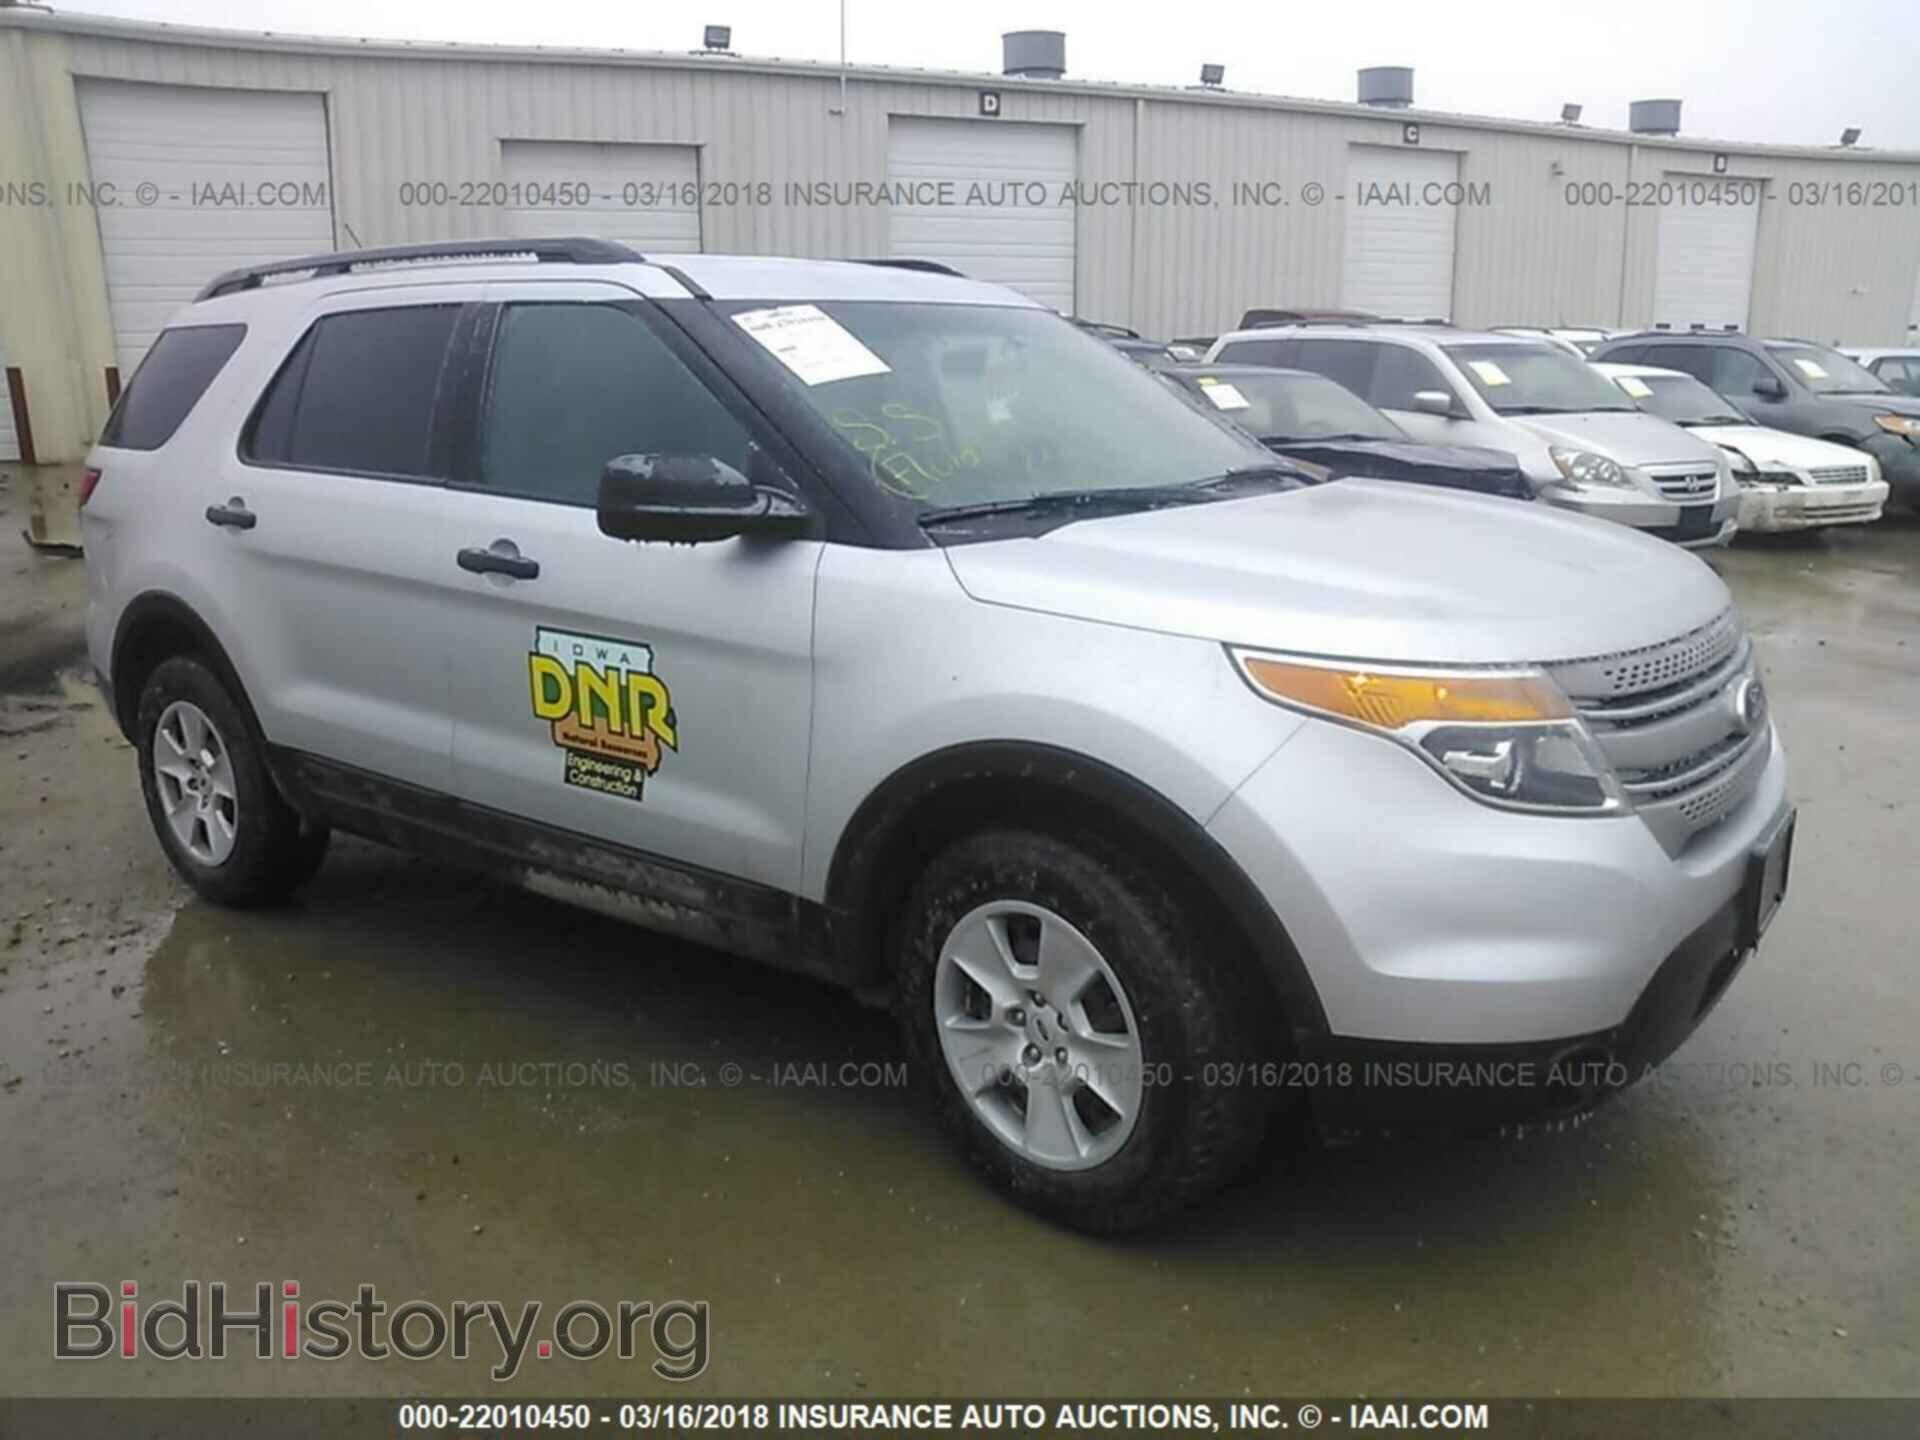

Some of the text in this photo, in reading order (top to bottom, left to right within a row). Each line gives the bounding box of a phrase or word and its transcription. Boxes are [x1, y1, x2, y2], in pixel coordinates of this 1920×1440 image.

[984, 95, 998, 111] D
[1408, 126, 1417, 140] C
[554, 640, 632, 665] IOWA
[529, 652, 678, 752] DNR
[567, 751, 632, 783] Engineering
[568, 768, 638, 798] Construction
